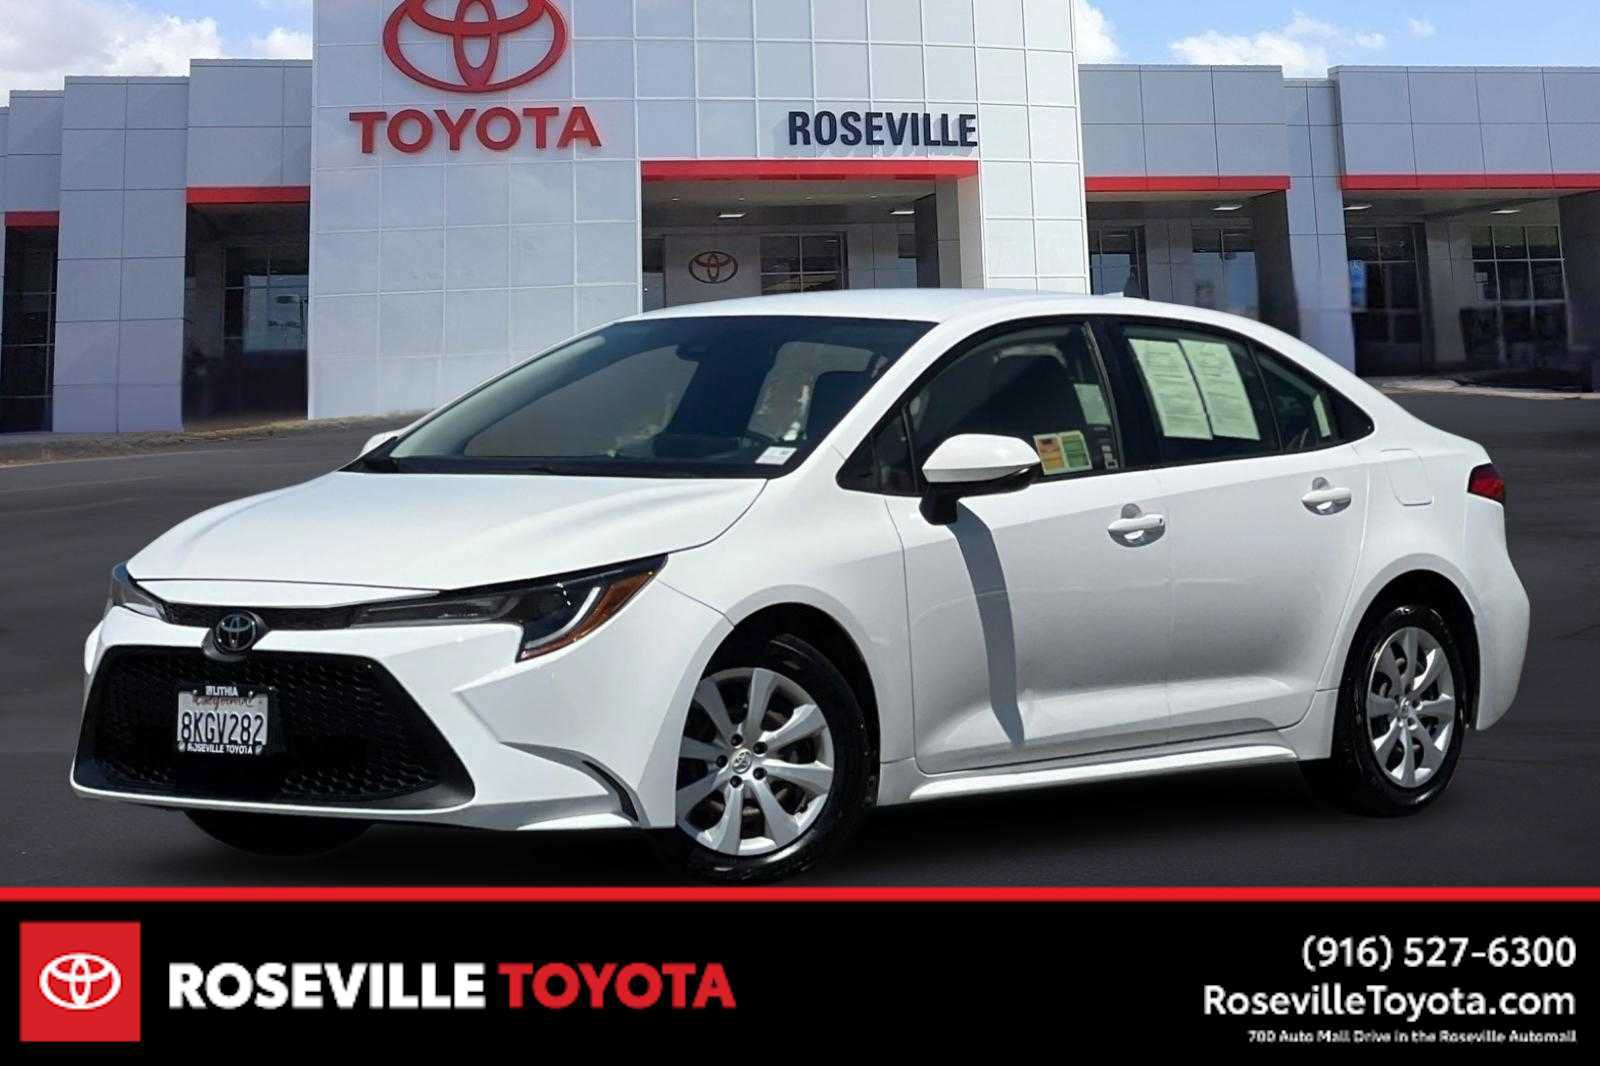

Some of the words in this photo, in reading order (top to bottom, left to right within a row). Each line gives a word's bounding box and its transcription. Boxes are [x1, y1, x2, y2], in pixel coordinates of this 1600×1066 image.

[349, 106, 602, 154] TOYOTA
[788, 110, 979, 147] ROSEVILLE
[181, 711, 264, 745] 8KGV282
[187, 742, 225, 753] ROSEVILLE
[226, 744, 253, 755] TOYOTA
